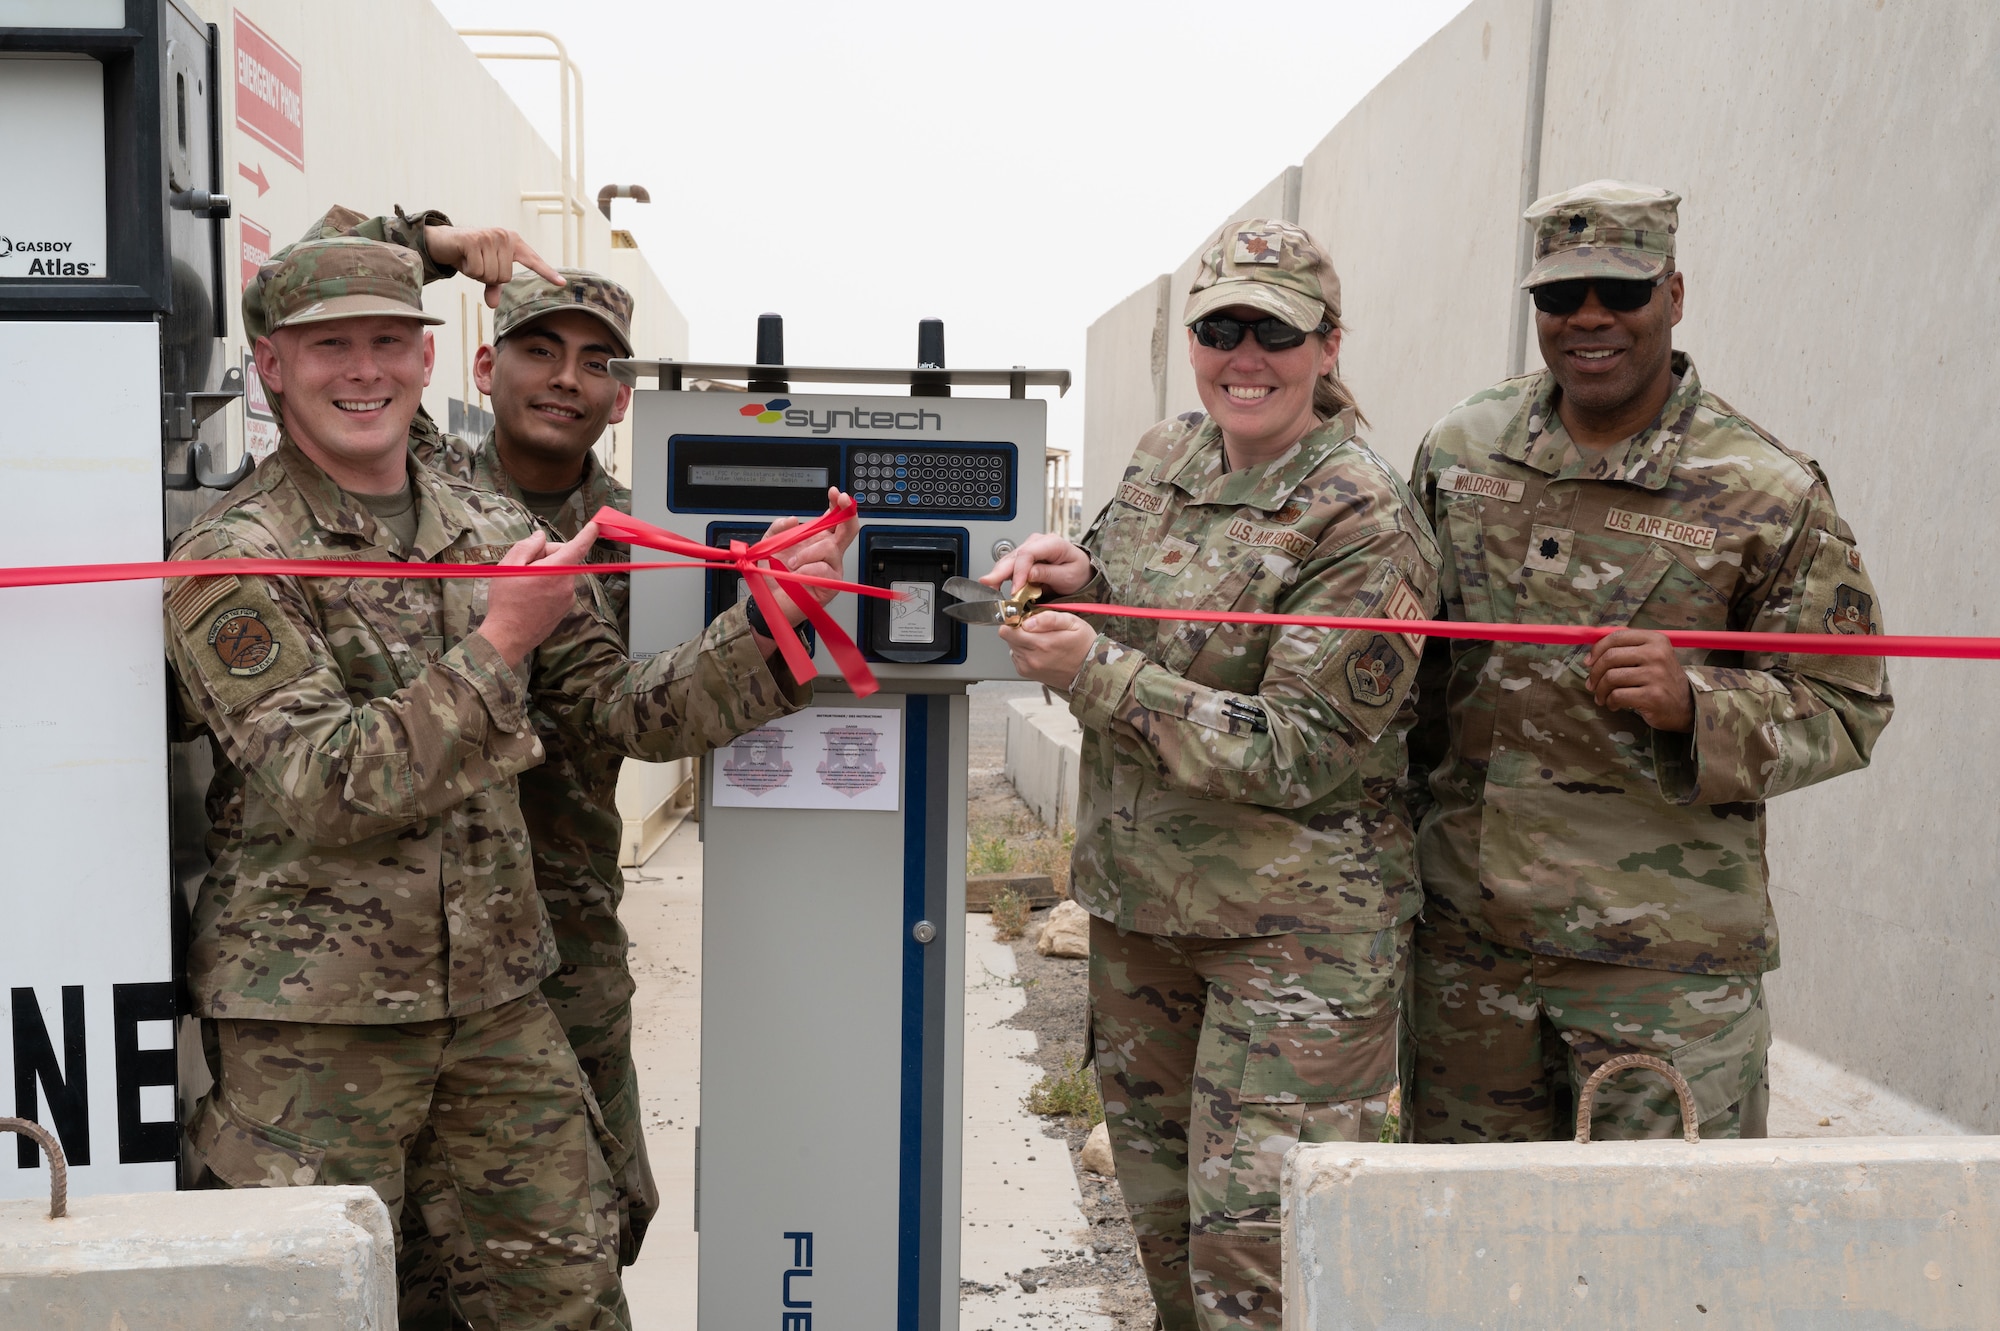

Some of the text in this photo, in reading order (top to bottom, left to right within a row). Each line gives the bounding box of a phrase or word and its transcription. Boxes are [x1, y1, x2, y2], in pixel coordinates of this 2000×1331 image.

[238, 48, 300, 128] EMERGENCY PHONE
[16, 242, 72, 252] GASBOY
[785, 407, 941, 434] syntech
[1454, 474, 1510, 498] WALDRON
[1230, 521, 1252, 542] U.S.
[1268, 532, 1311, 556] FORCE
[1609, 510, 1713, 546] U.S. AIR FORCE
[11, 982, 176, 1168] NE
